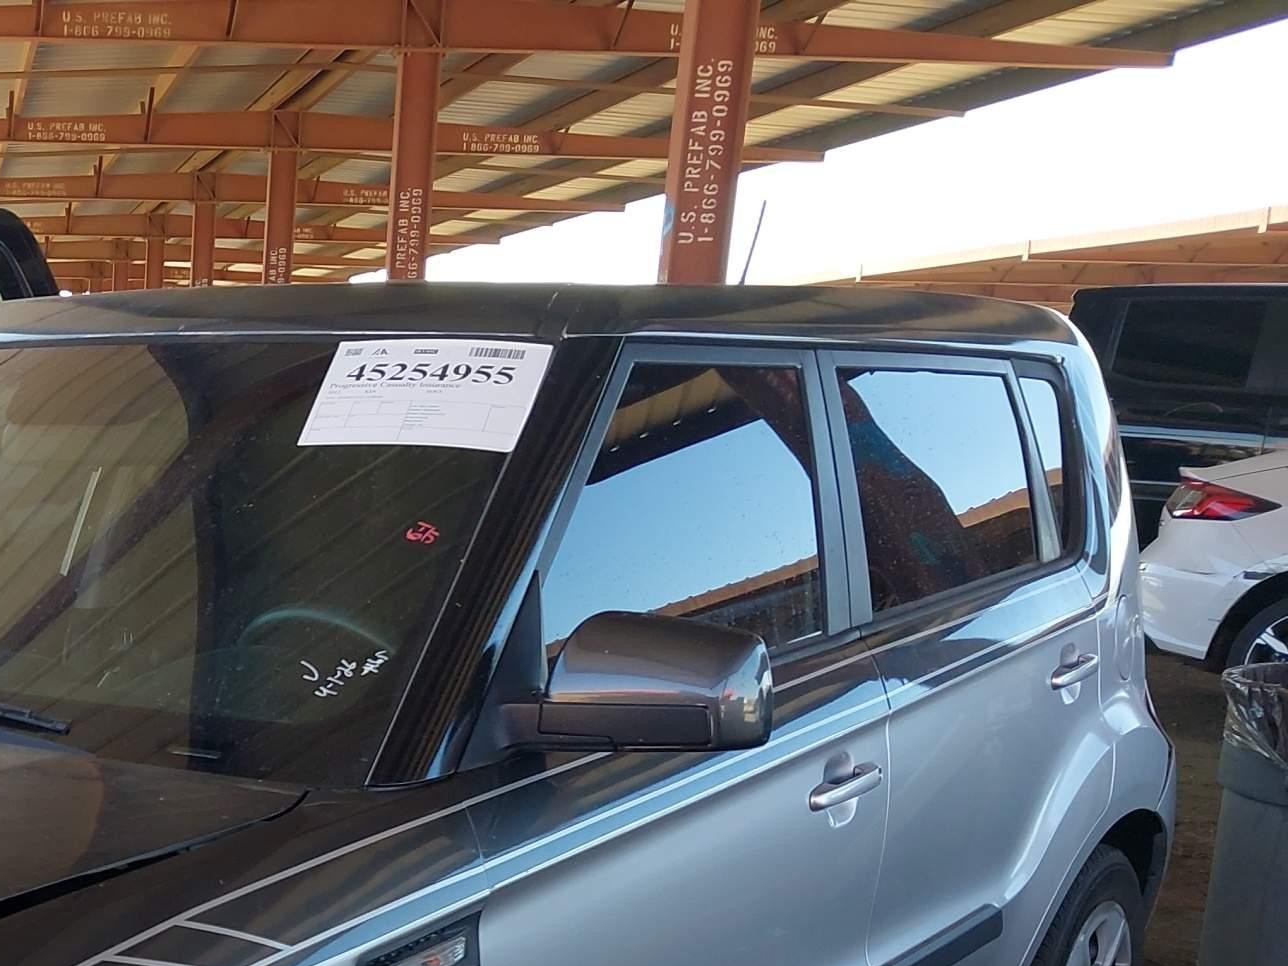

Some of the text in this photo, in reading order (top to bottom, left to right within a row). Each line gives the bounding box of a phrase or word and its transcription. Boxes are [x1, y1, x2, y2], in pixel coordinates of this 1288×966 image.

[93, 12, 143, 25] PREFAB
[50, 122, 85, 132] PREFAB
[484, 134, 520, 144] PREFAB
[697, 59, 734, 242] 1-866-799-0969
[678, 58, 715, 244] U.S. PREFAB INC.
[395, 219, 409, 269] PREFAB
[347, 362, 517, 385] 45254955
